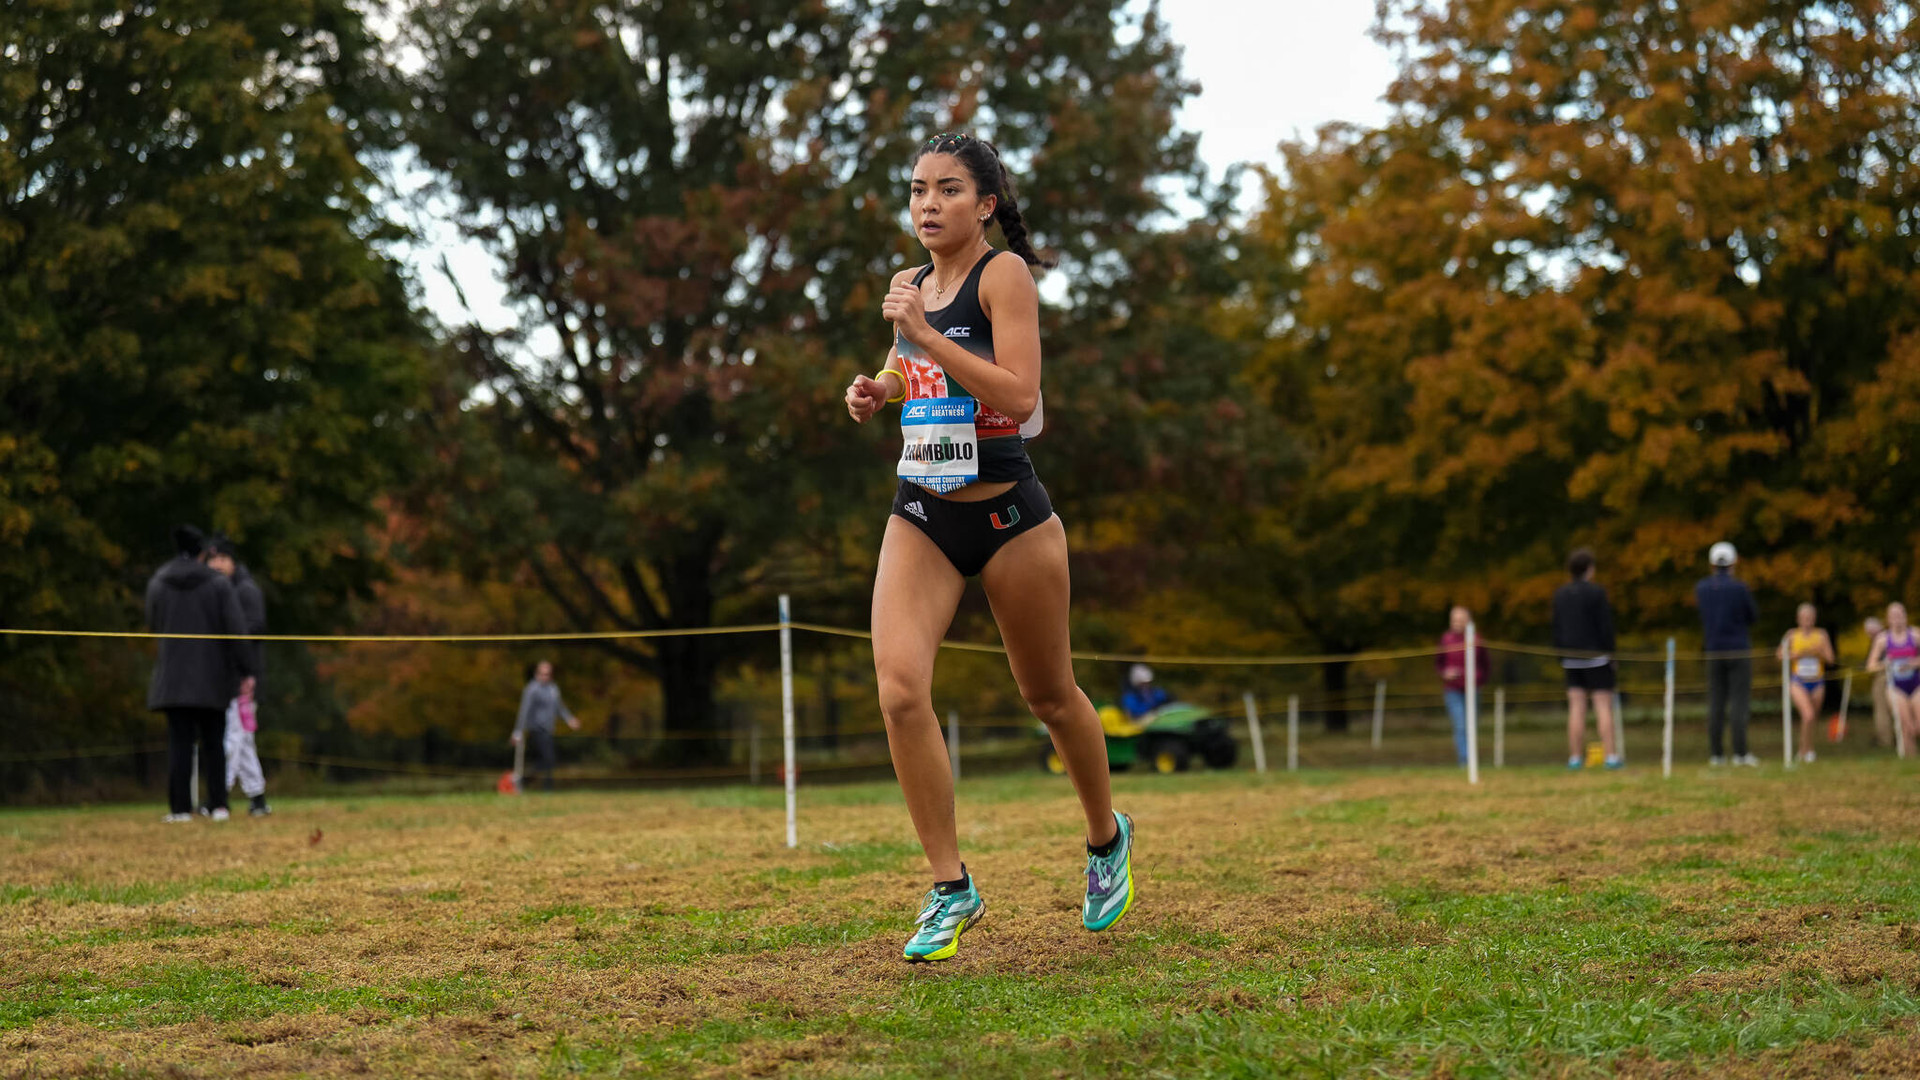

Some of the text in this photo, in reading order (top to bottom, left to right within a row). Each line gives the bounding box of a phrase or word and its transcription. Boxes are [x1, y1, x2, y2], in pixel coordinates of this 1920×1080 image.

[943, 327, 971, 337] ACC
[906, 405, 927, 418] ACC
[932, 409, 965, 417] GREATNESS
[990, 505, 1020, 530] U
